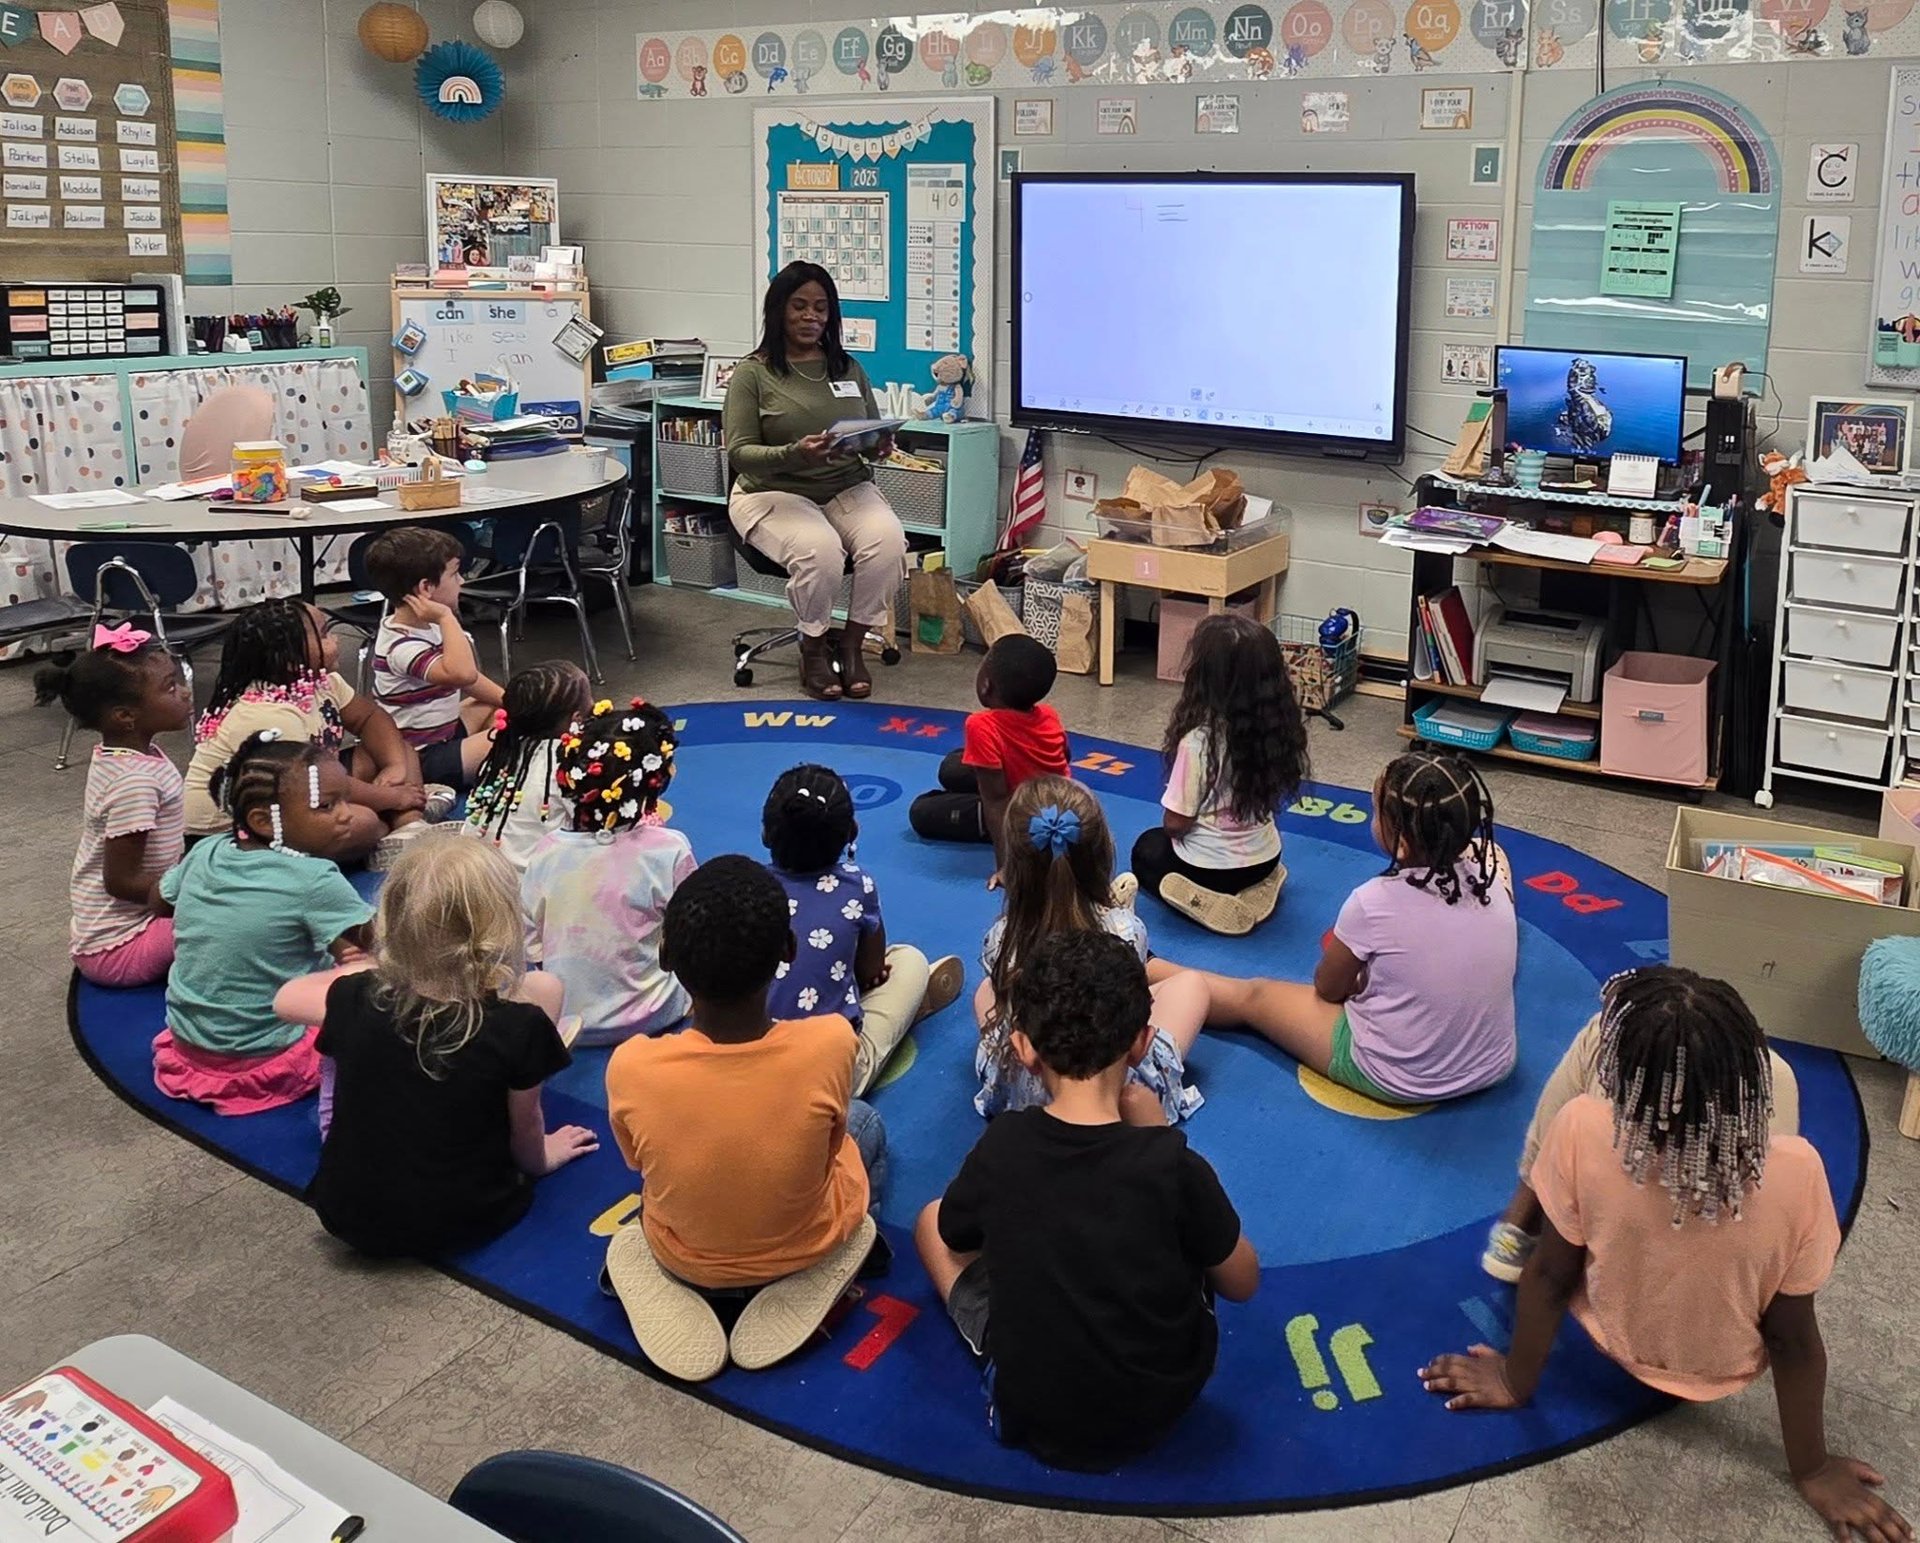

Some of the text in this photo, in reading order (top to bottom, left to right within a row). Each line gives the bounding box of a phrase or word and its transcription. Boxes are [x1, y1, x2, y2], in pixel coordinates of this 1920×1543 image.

[1353, 9, 1383, 38] Pp
[1417, 6, 1451, 33] Qq
[1551, 4, 1582, 24] Ss
[1175, 21, 1208, 41] Mm
[1234, 17, 1262, 40] Nn
[1292, 14, 1322, 36] Oo
[928, 33, 951, 55] Hh
[1025, 26, 1044, 54] Jj
[1071, 26, 1098, 49] Kk
[719, 45, 739, 64] Cc
[758, 43, 780, 63] Dd
[799, 41, 818, 61] Ee
[840, 37, 861, 59] Ff
[882, 36, 907, 60] Gg
[646, 52, 665, 68] Aa
[58, 122, 94, 135] Addison
[121, 126, 151, 140] Rhylie
[805, 121, 926, 151] Calendar
[9, 147, 43, 163] Parker
[64, 151, 96, 165] Stella
[125, 154, 155, 167] Layla
[794, 168, 832, 186] OCTOBER
[1482, 160, 1492, 175] d
[853, 168, 878, 187] 2025
[63, 182, 98, 194] Maddox
[931, 192, 959, 211] 4 0
[129, 211, 157, 222] Jacob
[1456, 221, 1490, 231] FICTION
[134, 237, 163, 253] Ryker
[436, 307, 465, 320] can
[490, 306, 516, 319] she
[442, 328, 527, 344] like see
[496, 352, 534, 365] can
[885, 381, 915, 420] M
[1142, 560, 1151, 575] 1
[743, 711, 837, 728] Ww
[878, 716, 948, 738] Xx
[1070, 752, 1136, 776] Zz
[1286, 795, 1368, 824] Bb
[1522, 870, 1624, 915] Dd
[1285, 1312, 1383, 1411] Jj
